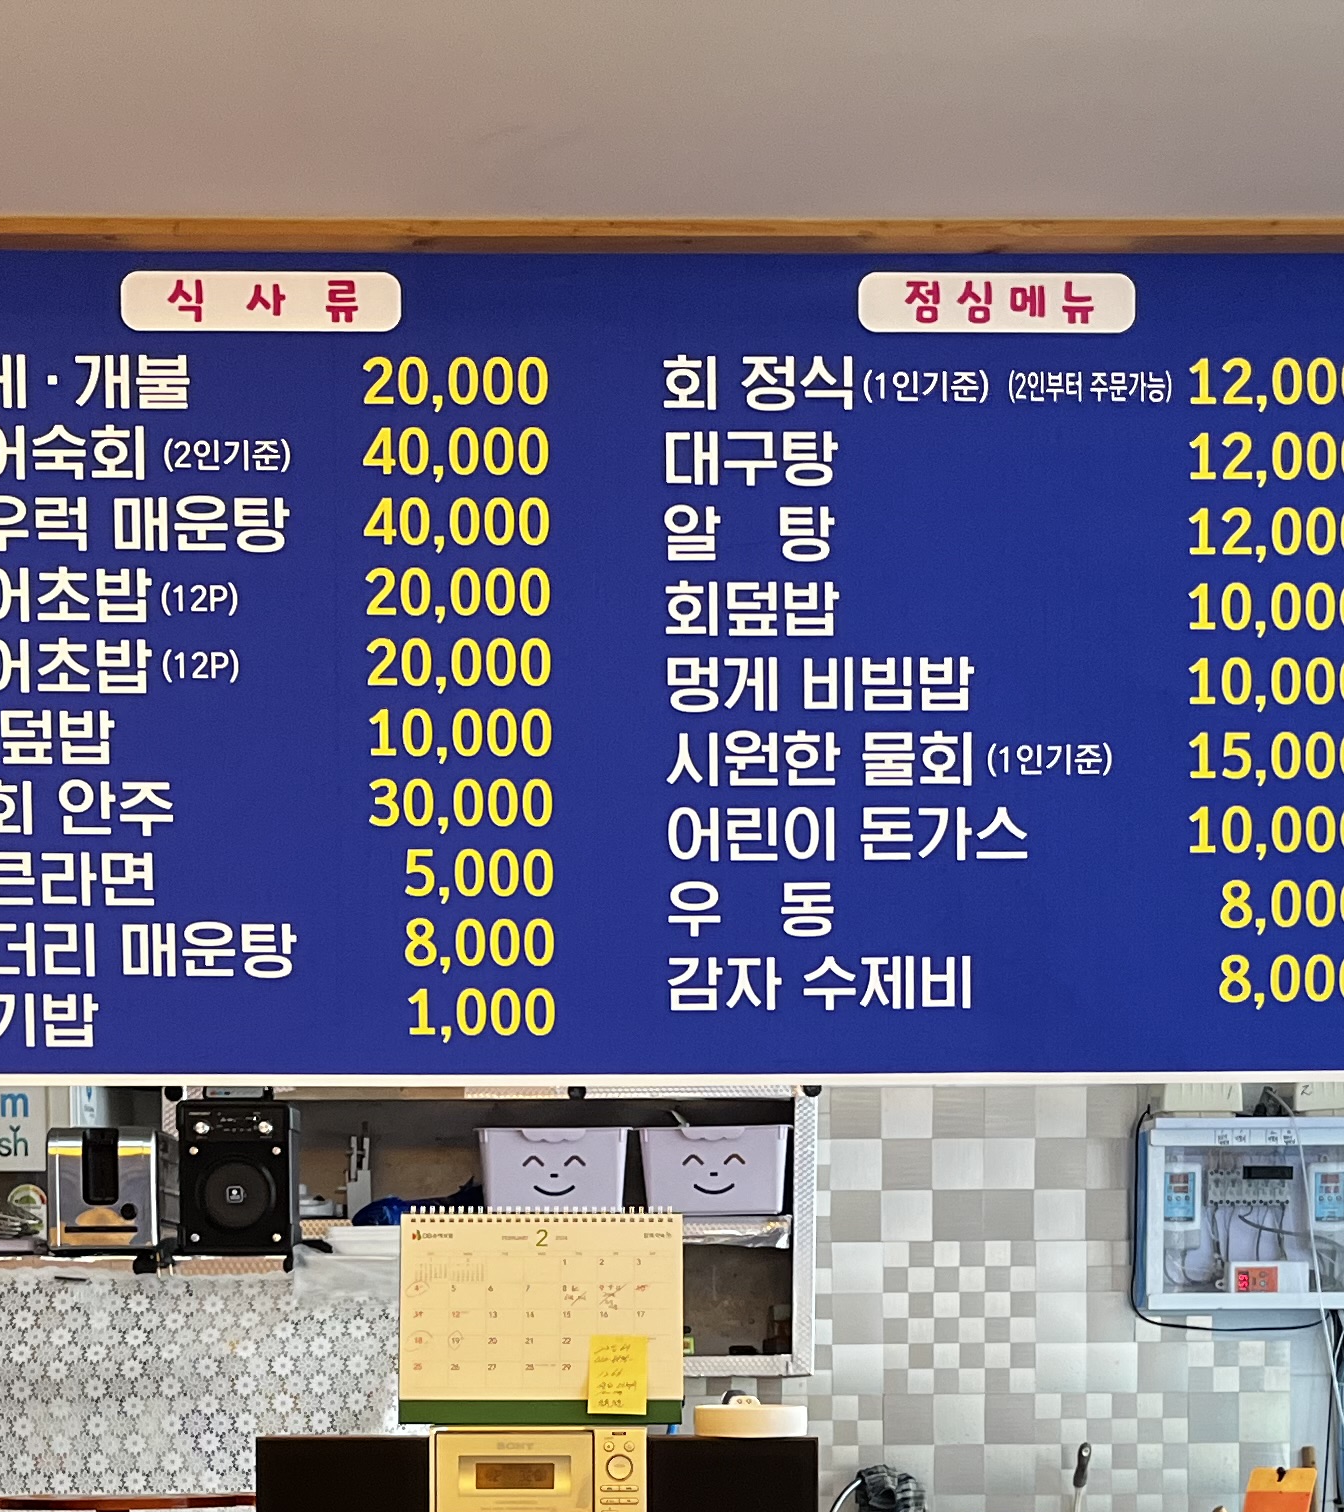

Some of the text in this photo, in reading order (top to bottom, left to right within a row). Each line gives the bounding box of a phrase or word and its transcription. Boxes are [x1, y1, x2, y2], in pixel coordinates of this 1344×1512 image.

[904, 279, 1095, 325] 점심메뉴
[75, 355, 190, 409] 개불
[363, 357, 548, 412] 20,000
[664, 355, 716, 410] 회
[742, 356, 854, 412] 정식
[864, 369, 989, 404] (1인기준)
[1009, 369, 1083, 404] (2인부터
[1090, 369, 1172, 404] 주문가능)
[164, 437, 291, 473] (2인기준)
[363, 427, 548, 483] 40,000
[666, 431, 838, 486] 대구탕
[114, 496, 290, 552] 매운탕
[364, 497, 549, 553] 40,000
[162, 581, 238, 617] (12P)
[365, 568, 550, 623] 20,000
[666, 580, 839, 636] 회덮밥
[163, 649, 239, 684] (12P)
[367, 638, 550, 694] 20,000
[667, 657, 777, 712] 멍게
[804, 657, 974, 711] 비빔밥
[1, 710, 115, 764] 덮밥
[369, 708, 551, 764] 10,000
[667, 730, 841, 786] 시원한
[862, 731, 973, 786] 물회
[988, 742, 1113, 778] (1인기준)
[59, 779, 173, 836] 안주
[369, 779, 552, 834] 30,000
[668, 807, 835, 861] 어린이
[861, 807, 1027, 860] 돈가스
[405, 849, 553, 904] 5,000
[122, 922, 297, 978] 매운탕
[405, 918, 554, 974] 8,000
[668, 956, 783, 1010] 감자
[804, 956, 971, 1010] 수제비
[408, 988, 555, 1043] 1,000
[535, 1229, 549, 1247] 2
